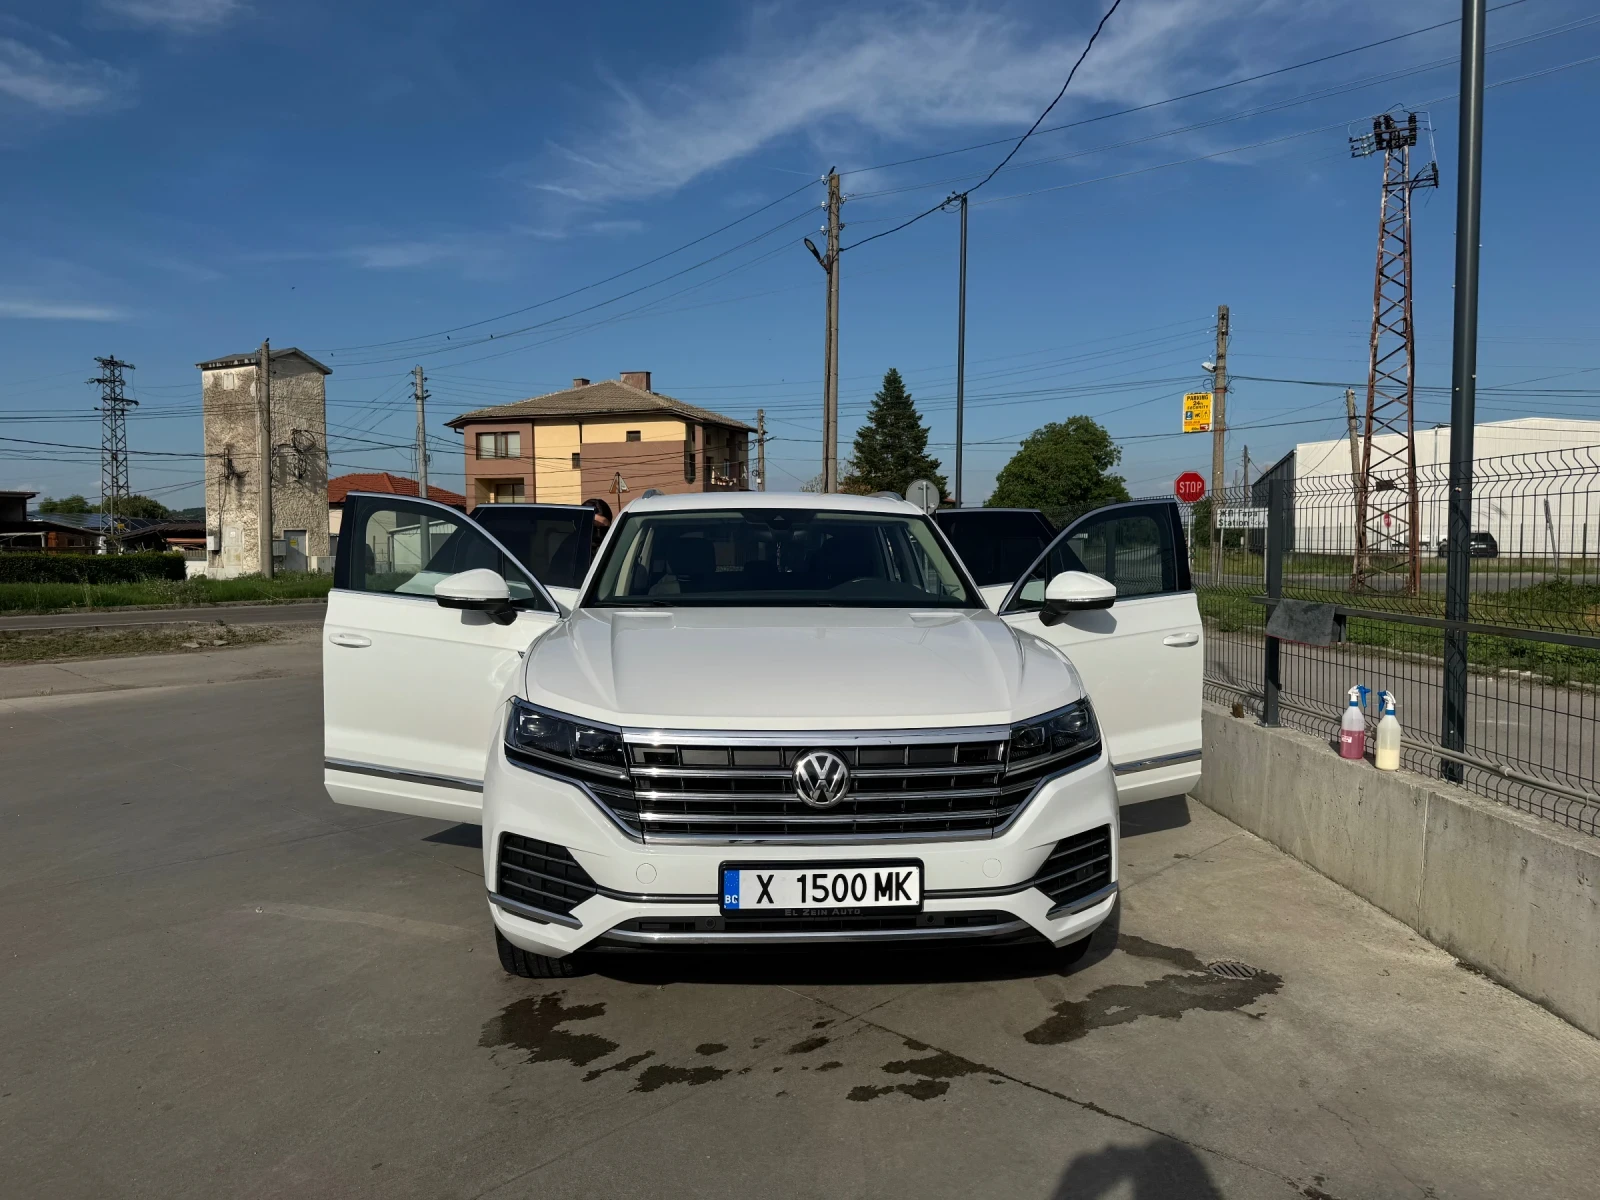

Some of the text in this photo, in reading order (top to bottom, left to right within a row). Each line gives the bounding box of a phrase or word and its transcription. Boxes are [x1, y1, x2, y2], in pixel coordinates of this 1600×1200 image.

[1179, 481, 1202, 493] STOP
[1219, 509, 1234, 517] ЖП
[1218, 519, 1249, 527] Station
[756, 871, 914, 904] X 1500 MK
